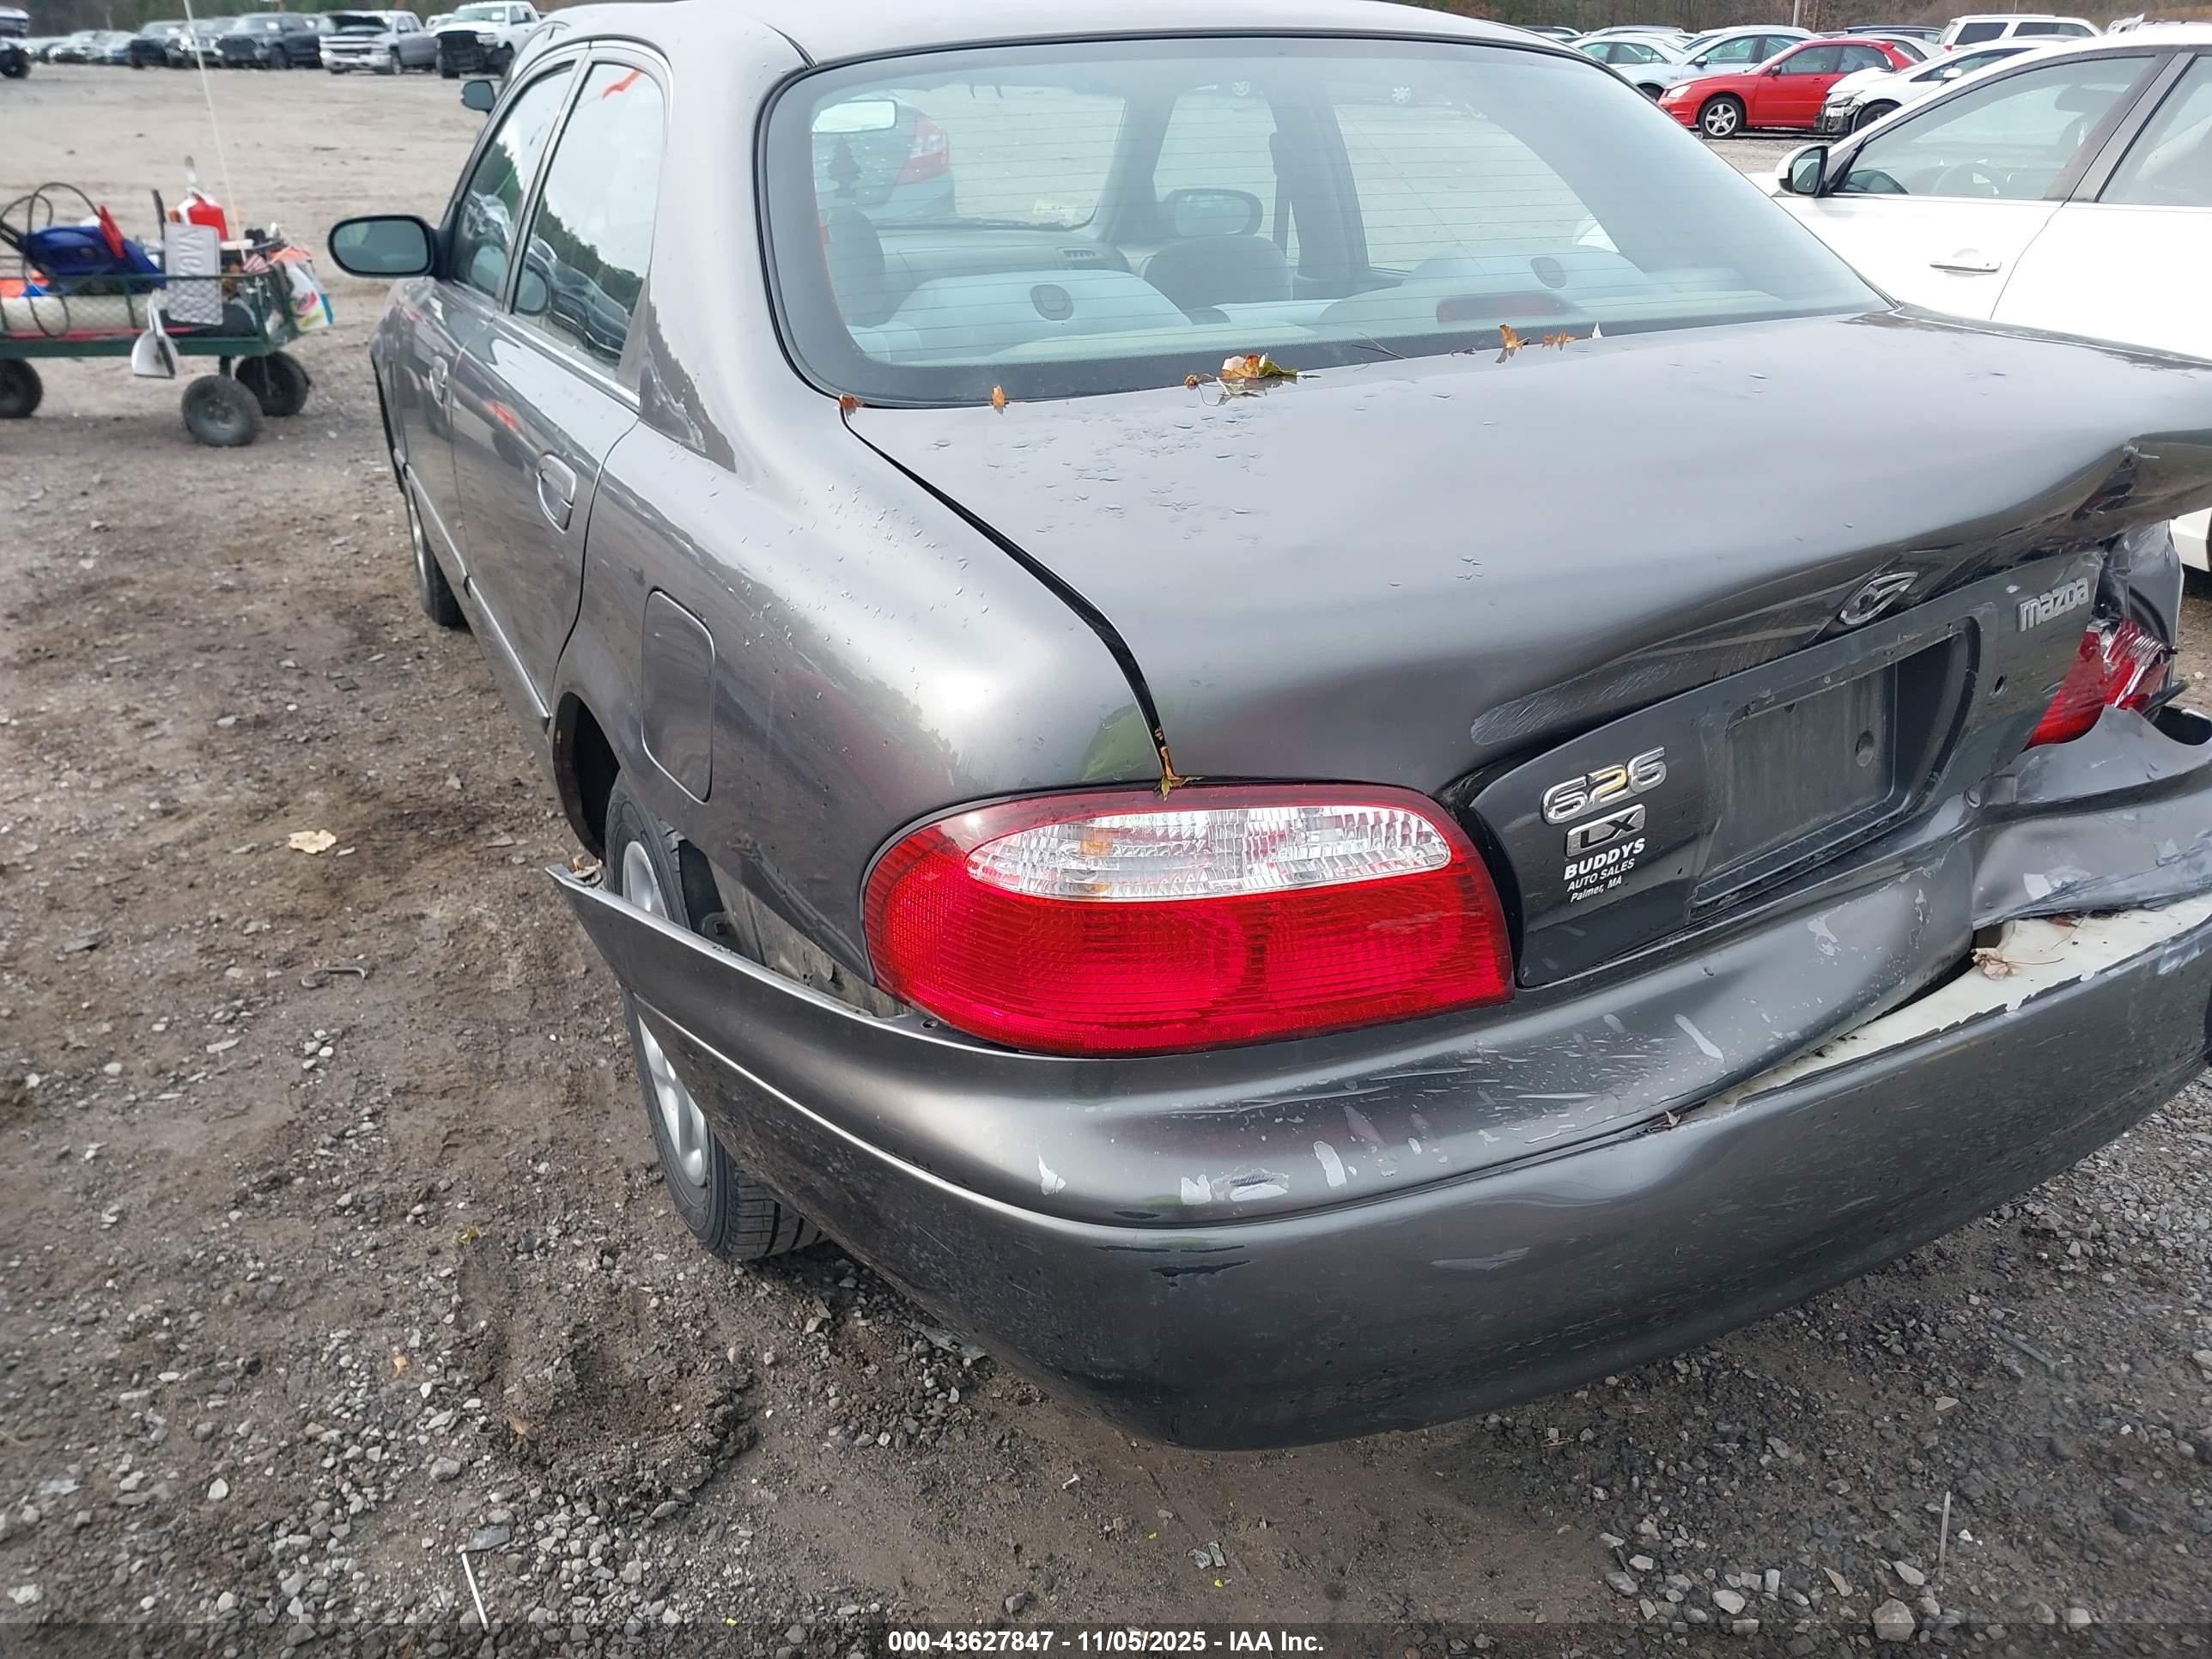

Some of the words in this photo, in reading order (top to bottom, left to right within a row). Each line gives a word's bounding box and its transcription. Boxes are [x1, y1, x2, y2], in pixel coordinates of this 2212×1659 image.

[2019, 577, 2089, 632] mazda
[1542, 745, 1667, 825] 626
[1580, 810, 1640, 849] LX
[1564, 837, 1645, 880] BUDDYS
[1567, 872, 1598, 892] AUTO
[1600, 858, 1635, 880] SALES
[1570, 884, 1605, 902] Palmer,
[1607, 875, 1622, 889] MA
